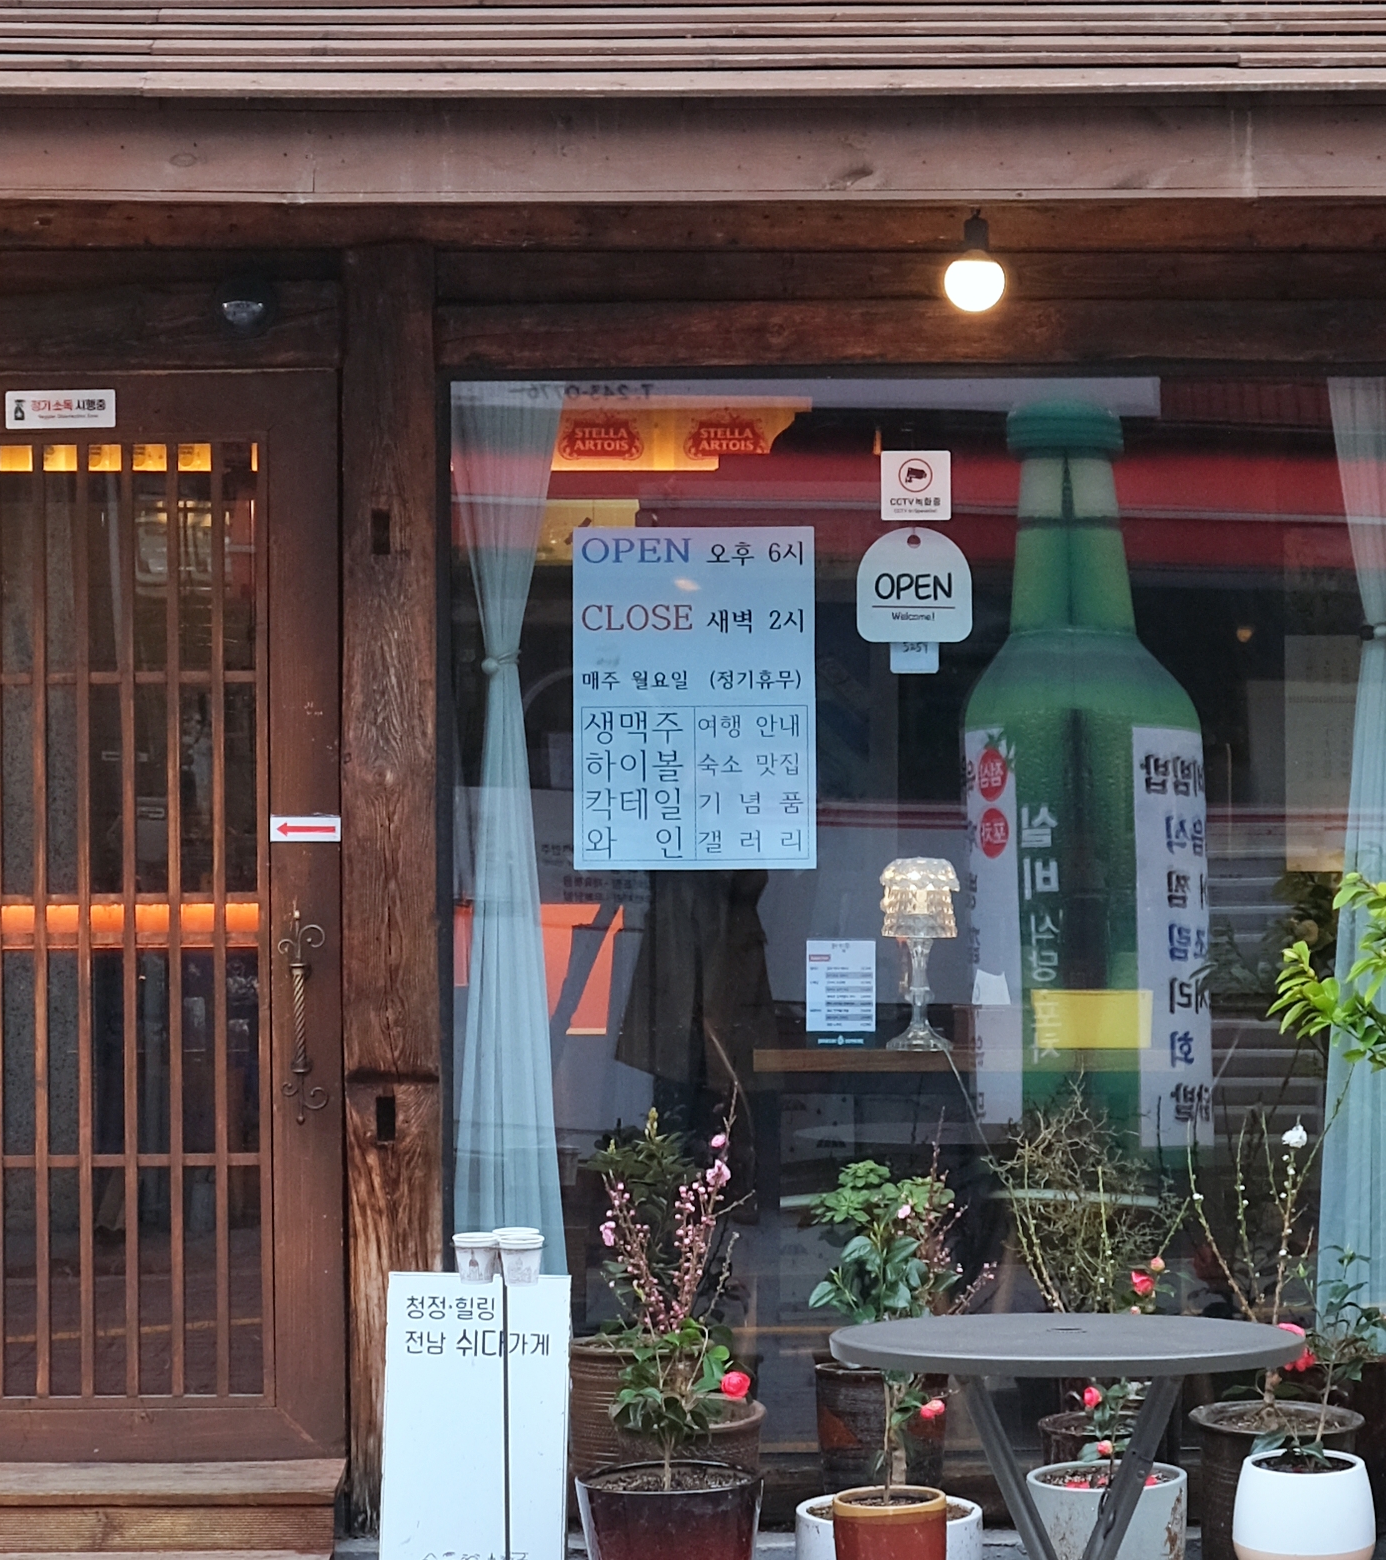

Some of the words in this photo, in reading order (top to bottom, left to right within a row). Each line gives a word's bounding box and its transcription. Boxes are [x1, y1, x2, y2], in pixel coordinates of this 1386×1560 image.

[52, 399, 73, 411] 소독
[75, 398, 106, 411] 시행중
[573, 440, 629, 451] ARTOIS
[574, 428, 628, 439] STELLA
[698, 440, 754, 451] ARTOIS
[699, 428, 753, 439] STELLA
[581, 537, 693, 564] OPEN
[706, 541, 755, 566] 오후
[768, 540, 804, 566] 6시
[874, 572, 953, 601] OPEN
[581, 604, 693, 631] CLOSE
[706, 608, 753, 634] 새벽
[769, 608, 804, 633] 2시
[891, 611, 935, 622] Welcome!
[582, 670, 621, 690] 매주
[631, 670, 688, 690] 월요일
[709, 669, 802, 690] (정기휴무)
[584, 710, 684, 745] 생맥주
[698, 714, 741, 739] 여행
[756, 713, 800, 738] 안내
[585, 749, 684, 783] 하이볼
[697, 753, 743, 776] 숙소
[756, 752, 799, 777] 맛집
[585, 787, 682, 821] 칵테일
[405, 1295, 496, 1321] 청정·힐링
[404, 1329, 447, 1355] 전남
